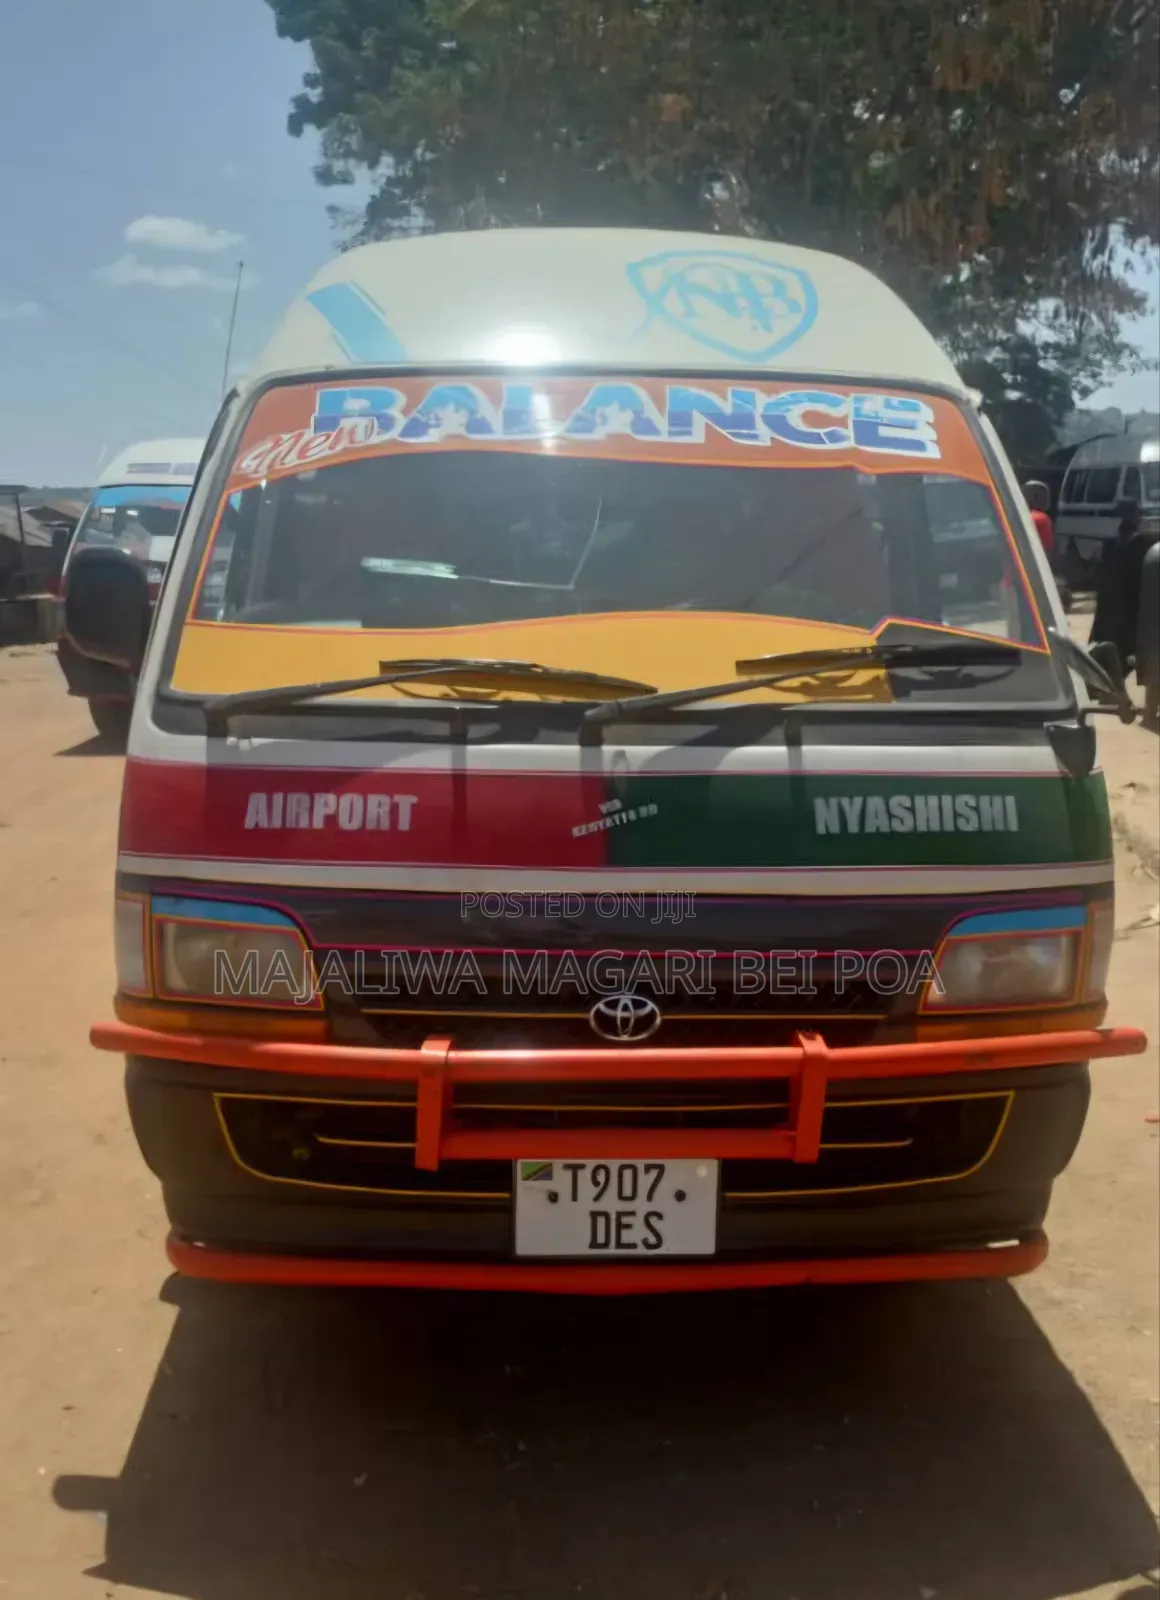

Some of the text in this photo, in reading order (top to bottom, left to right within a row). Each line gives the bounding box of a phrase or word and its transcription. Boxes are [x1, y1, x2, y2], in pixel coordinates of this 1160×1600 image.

[311, 383, 941, 459] BALANCE
[244, 791, 418, 831] AIRPORT
[813, 794, 1019, 834] NYASHISHI
[562, 1163, 666, 1203] T907
[588, 1210, 664, 1251] DES
